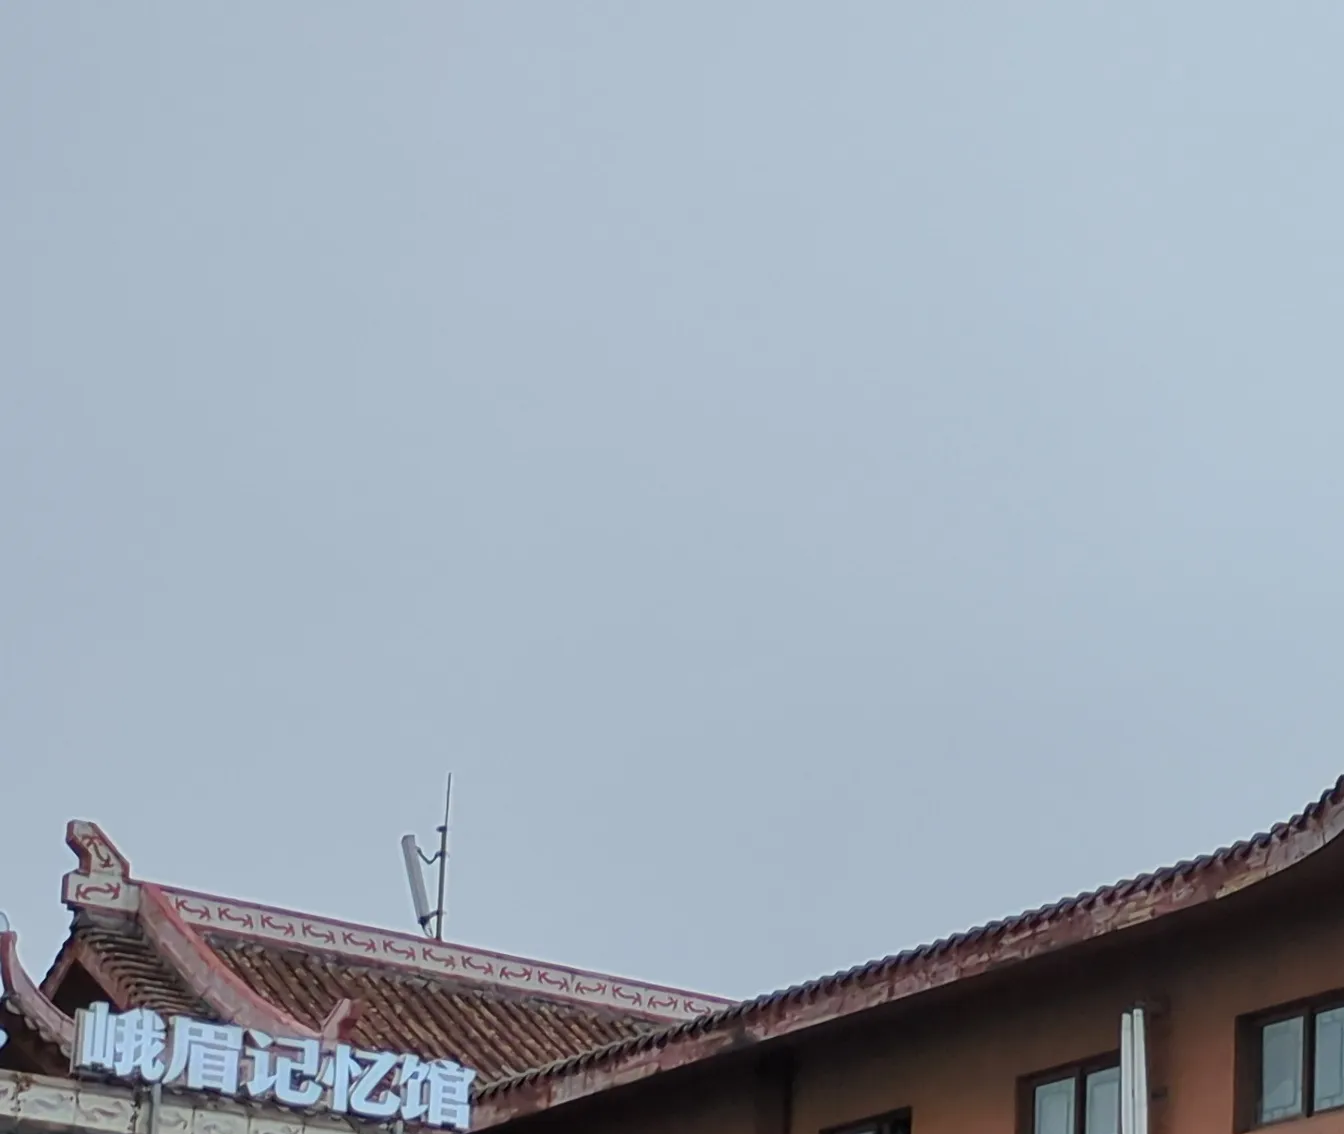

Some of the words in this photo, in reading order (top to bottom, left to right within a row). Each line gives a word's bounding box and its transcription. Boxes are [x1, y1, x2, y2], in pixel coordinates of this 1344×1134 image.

[80, 1001, 476, 1130] 峨眉记忆馆
